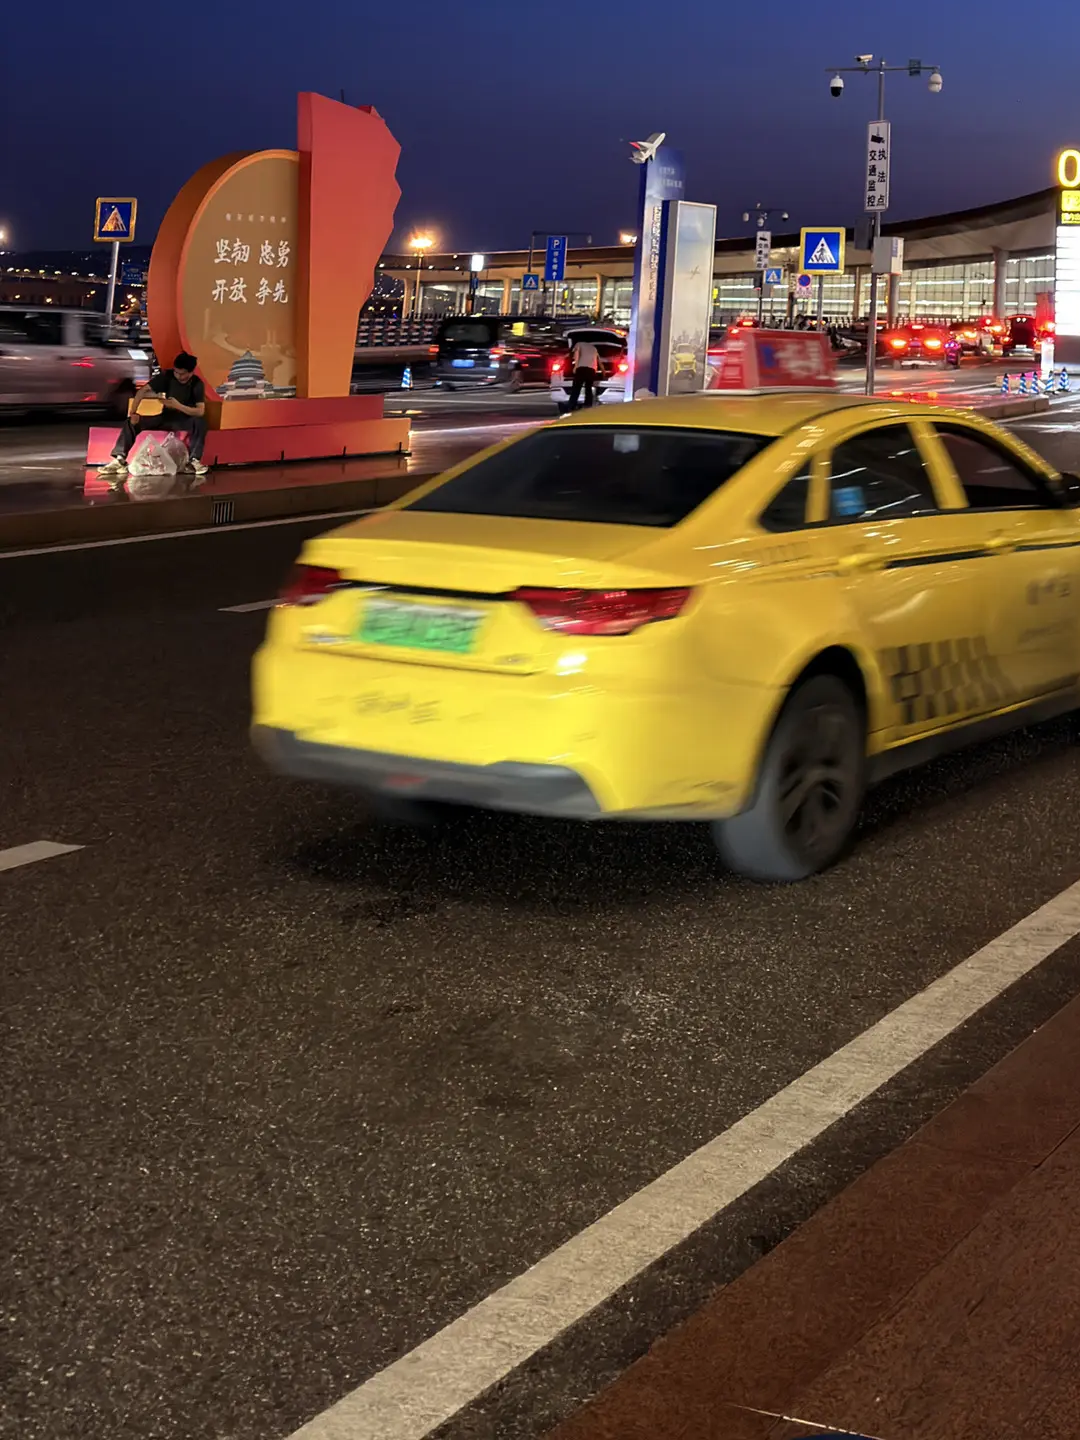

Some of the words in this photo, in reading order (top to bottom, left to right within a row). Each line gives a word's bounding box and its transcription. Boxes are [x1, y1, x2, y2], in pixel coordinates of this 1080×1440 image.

[867, 149, 877, 207] 交通监控
[877, 148, 887, 207] 执法点
[214, 238, 250, 267] 坚韧
[259, 240, 291, 268] 忠勇
[553, 239, 560, 249] P
[212, 277, 247, 304] 开放
[255, 277, 289, 305] 争先
